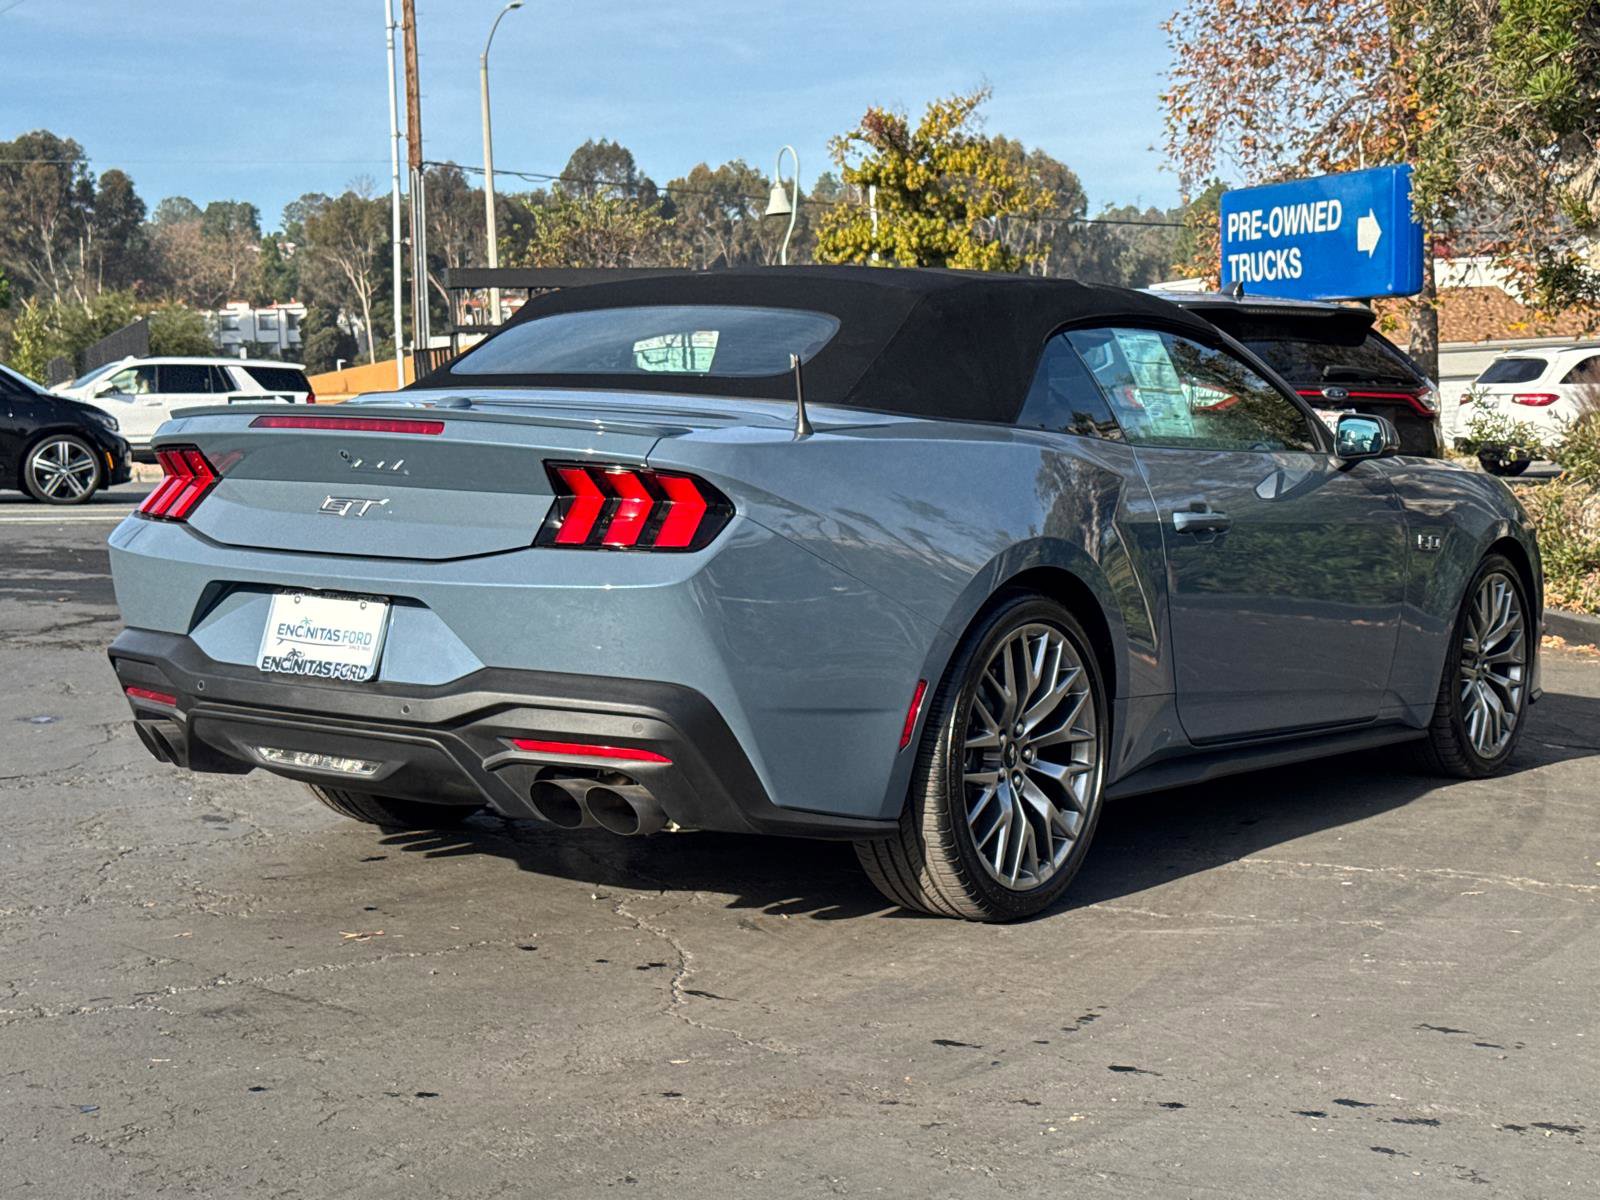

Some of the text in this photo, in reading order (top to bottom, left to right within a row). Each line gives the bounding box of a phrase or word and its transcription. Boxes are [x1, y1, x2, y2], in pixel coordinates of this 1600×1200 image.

[1228, 199, 1342, 243] PRE-OWNED
[1228, 247, 1302, 282] TRUCKS
[318, 495, 390, 517] GT
[342, 630, 372, 645] FORD
[261, 650, 368, 680] ENCINITAS FORD
